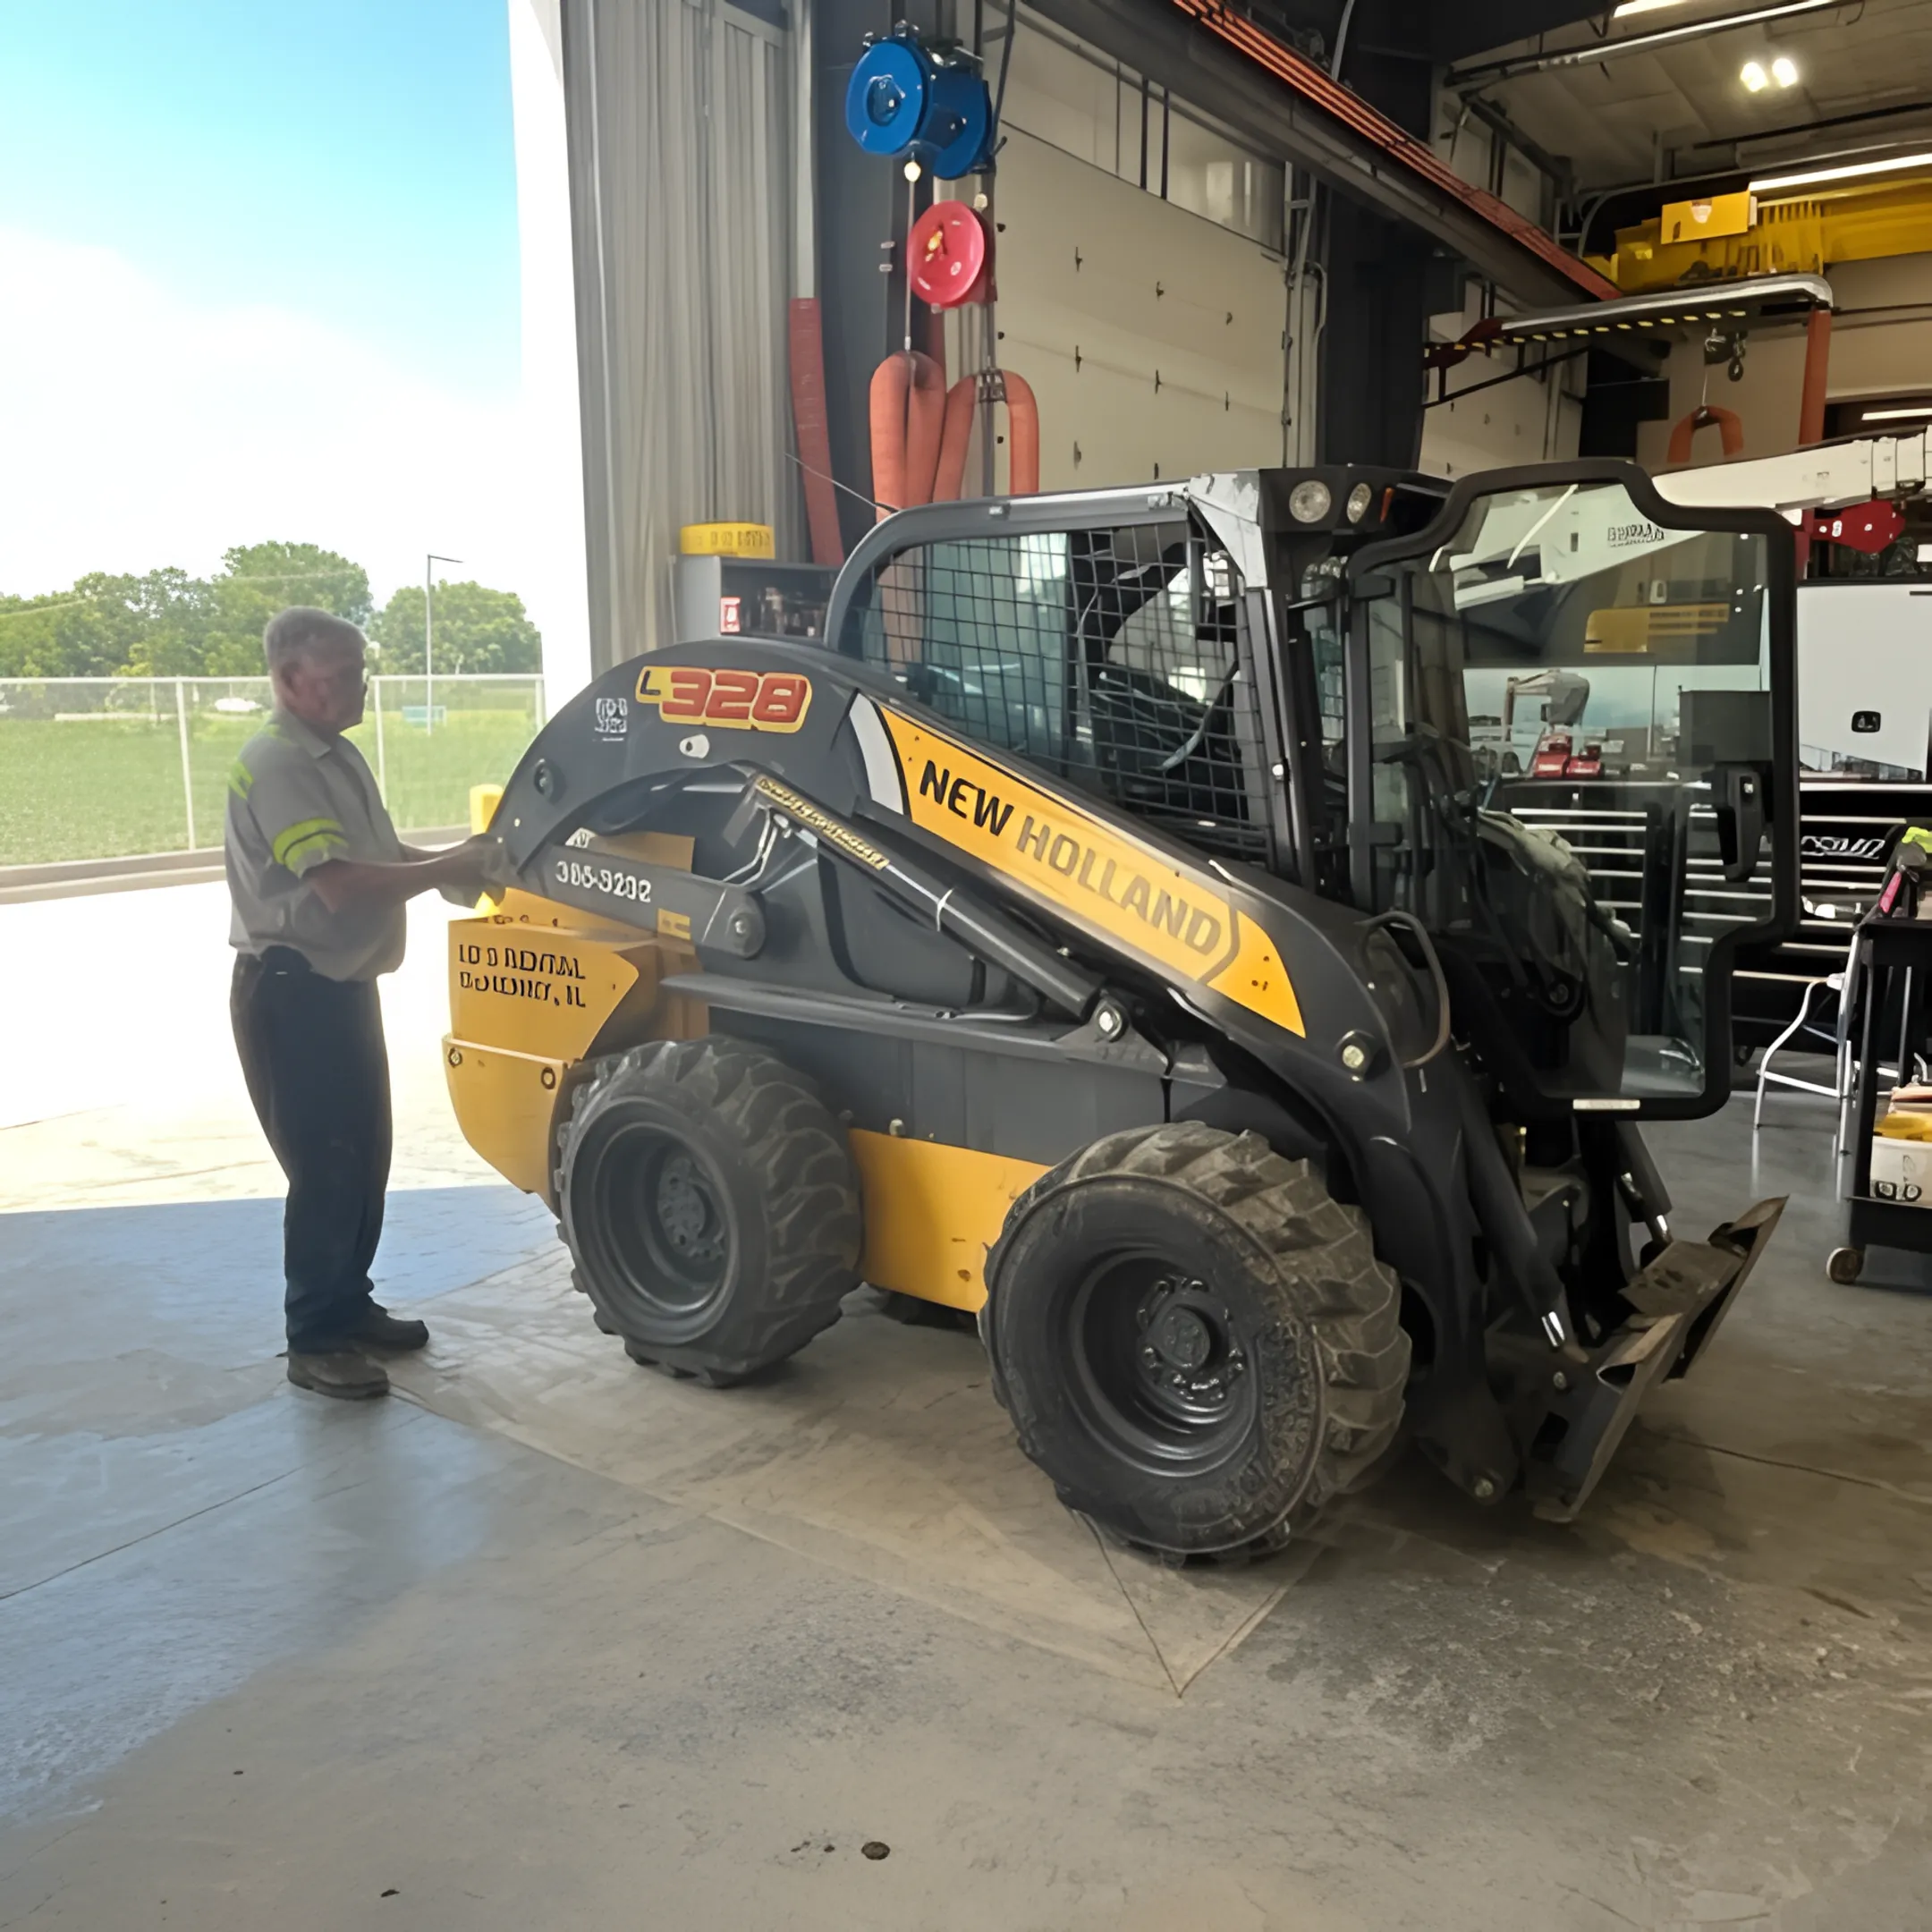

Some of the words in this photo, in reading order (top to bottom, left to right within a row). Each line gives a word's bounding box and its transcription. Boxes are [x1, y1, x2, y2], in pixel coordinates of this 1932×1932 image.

[638, 668, 809, 727] L328
[919, 759, 1014, 837] NEW
[1016, 815, 1222, 956] HOLLAND
